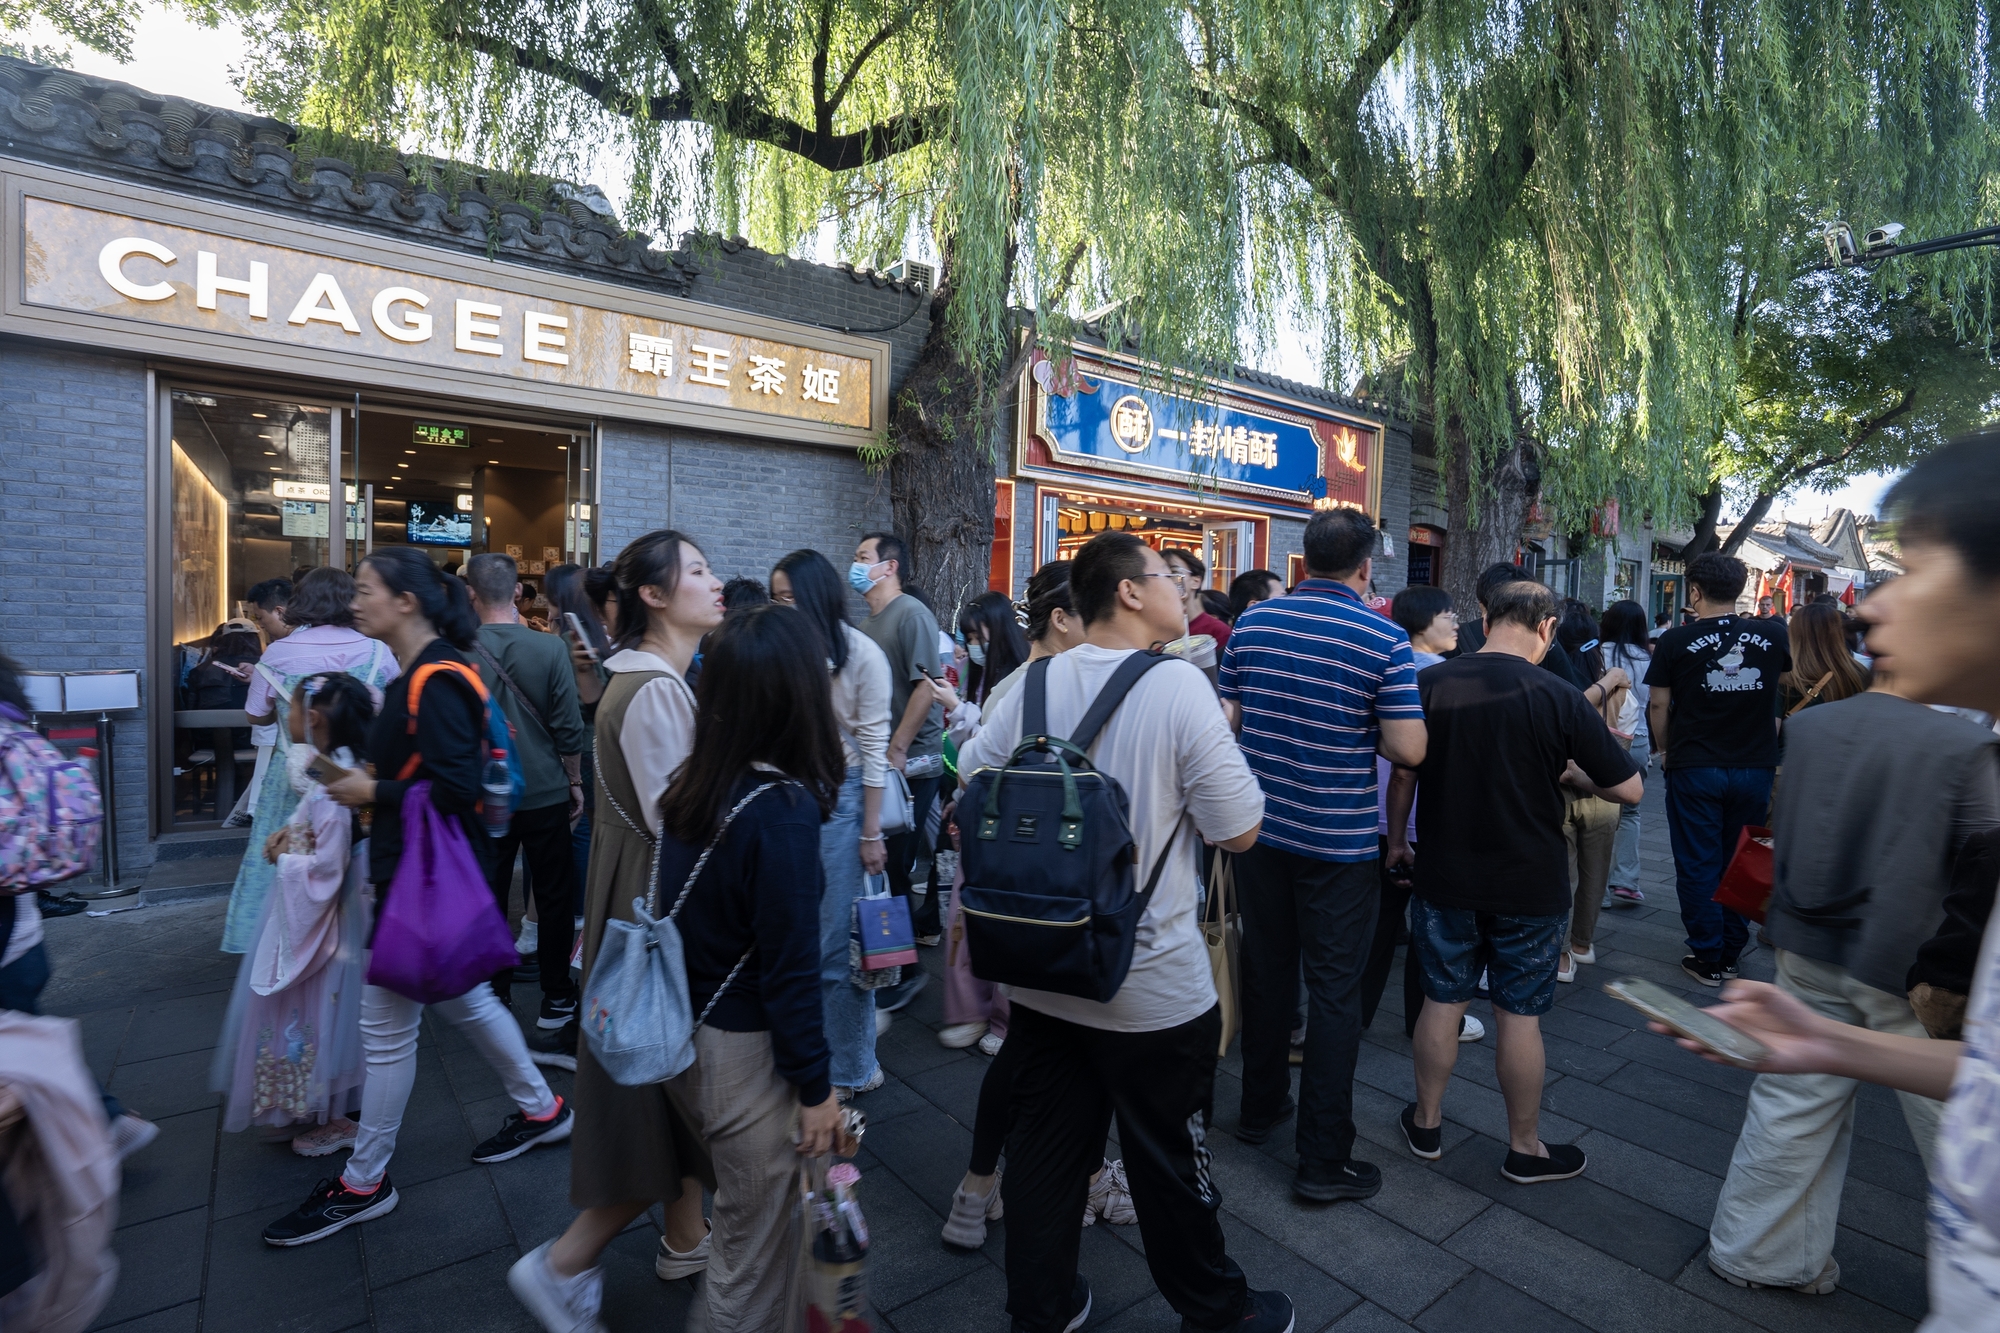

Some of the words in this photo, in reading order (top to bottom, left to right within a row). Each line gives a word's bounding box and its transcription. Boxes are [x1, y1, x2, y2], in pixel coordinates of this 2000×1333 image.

[98, 237, 569, 365] CHAGEE
[629, 332, 840, 405] 霸王茶姬
[1686, 632, 1721, 653] NEW
[1725, 632, 1773, 651] ORK
